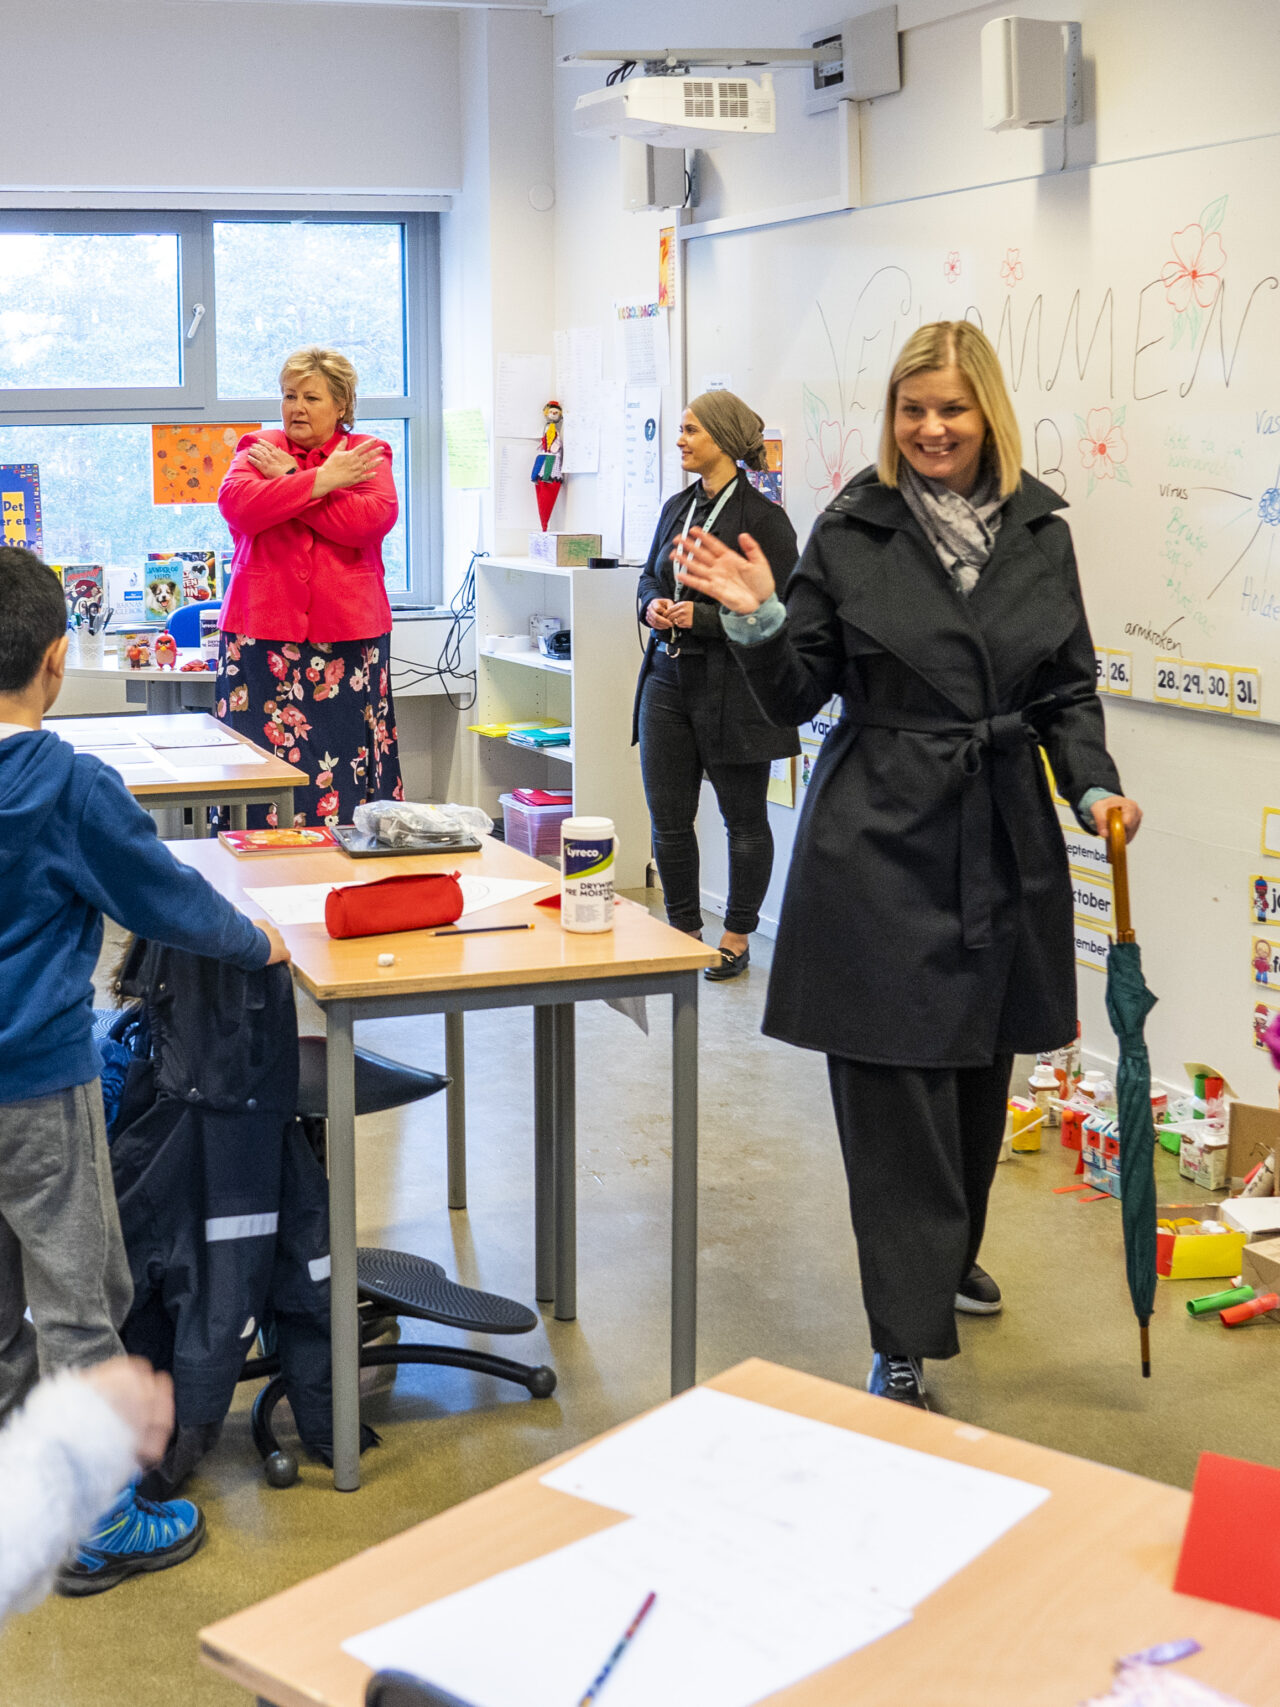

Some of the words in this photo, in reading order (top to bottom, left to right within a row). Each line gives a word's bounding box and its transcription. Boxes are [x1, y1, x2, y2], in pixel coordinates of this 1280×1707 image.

[3, 500, 24, 512] Det
[0, 518, 11, 526] er
[16, 517, 31, 526] en
[1110, 662, 1129, 683] 26.
[1157, 669, 1179, 691] 28.
[1183, 673, 1204, 695] 29.
[1208, 675, 1229, 698] 30.
[1236, 679, 1257, 705] 31.
[567, 847, 599, 858] Lyreco
